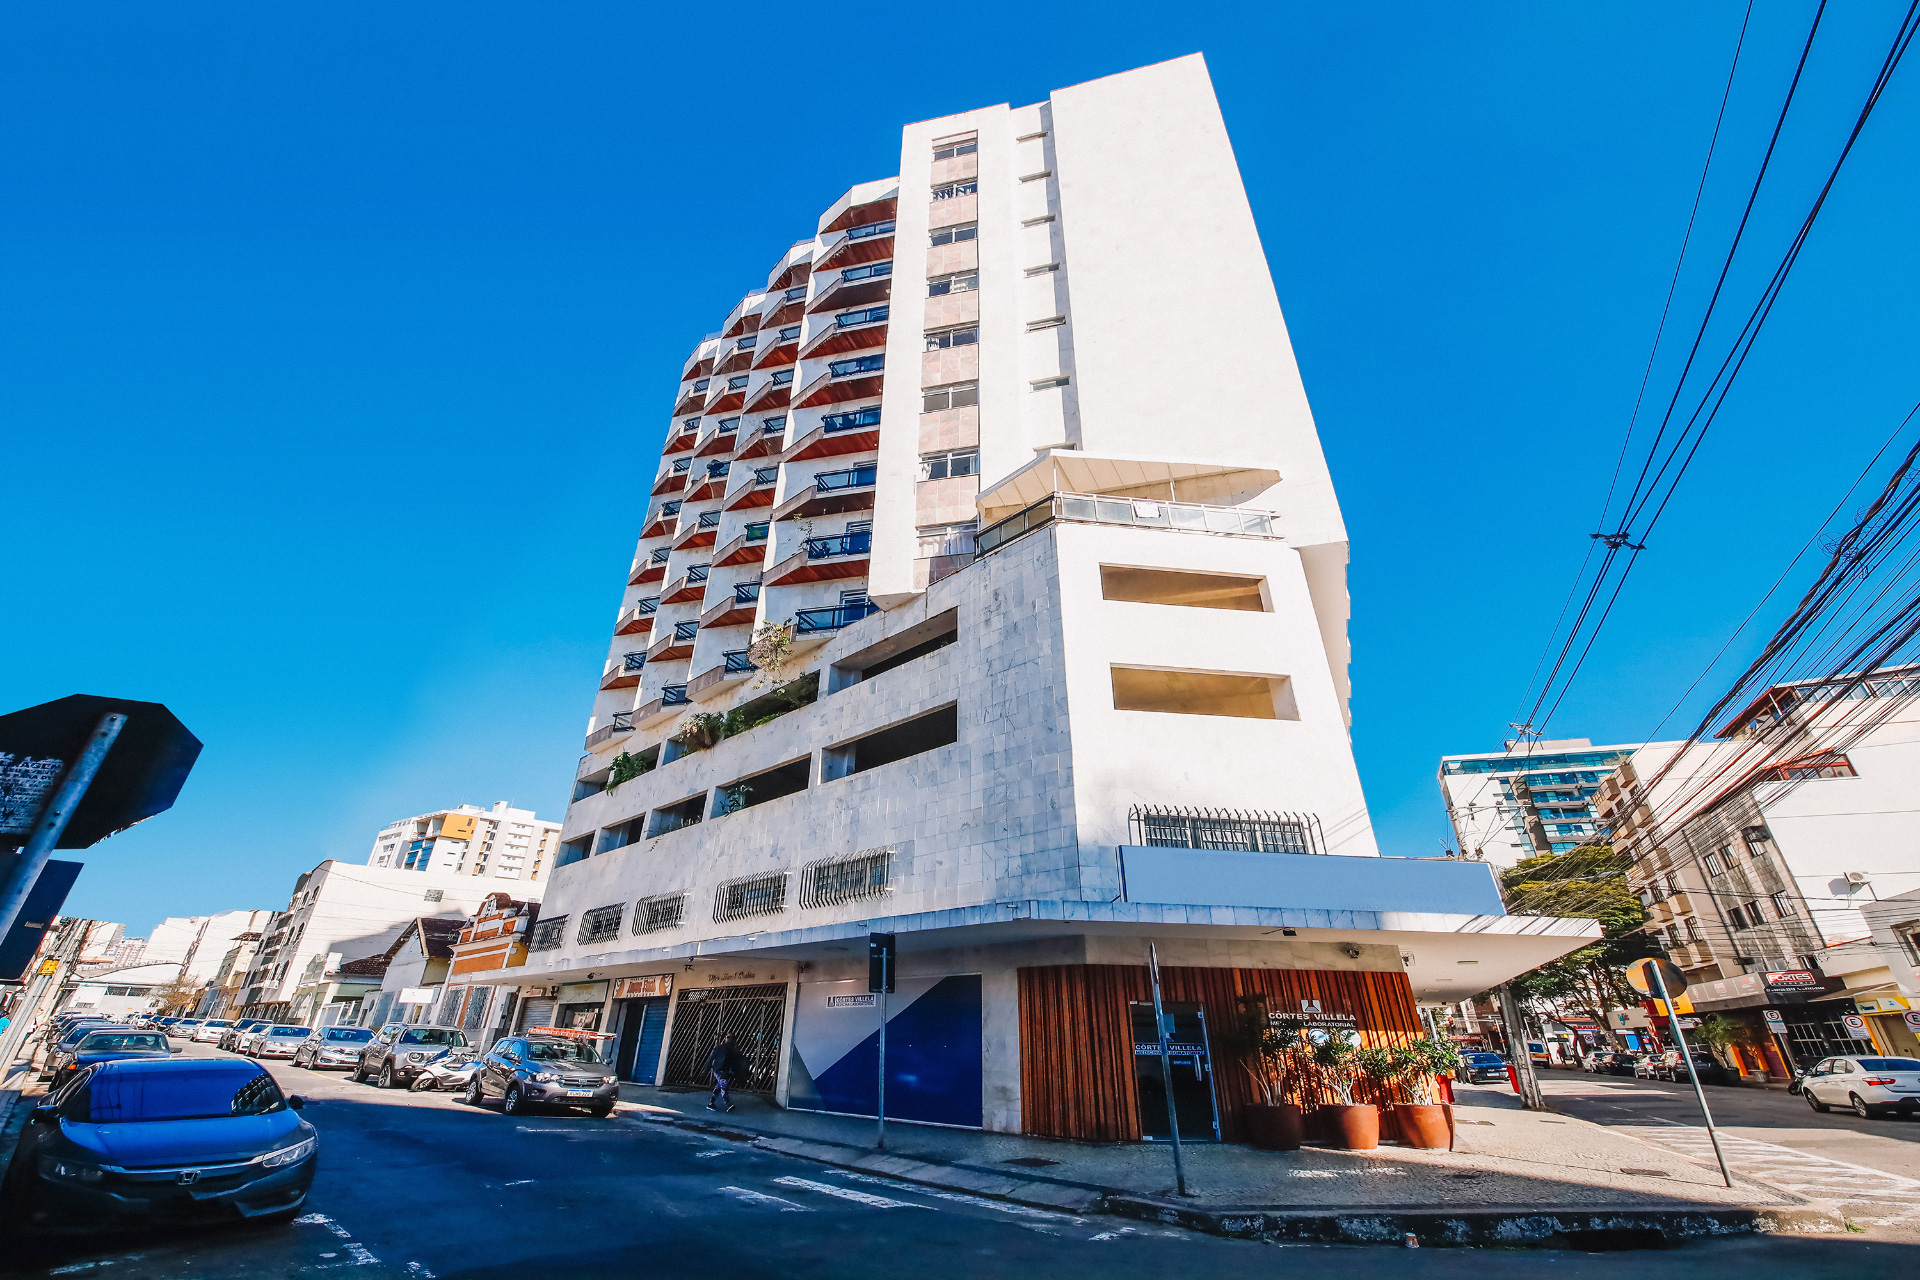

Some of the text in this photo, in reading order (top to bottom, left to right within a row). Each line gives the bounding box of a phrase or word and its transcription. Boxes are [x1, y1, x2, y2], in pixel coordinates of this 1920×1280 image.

[1268, 1010, 1357, 1021] CÔRTES VILLELA
[1911, 1014, 1920, 1022] E
